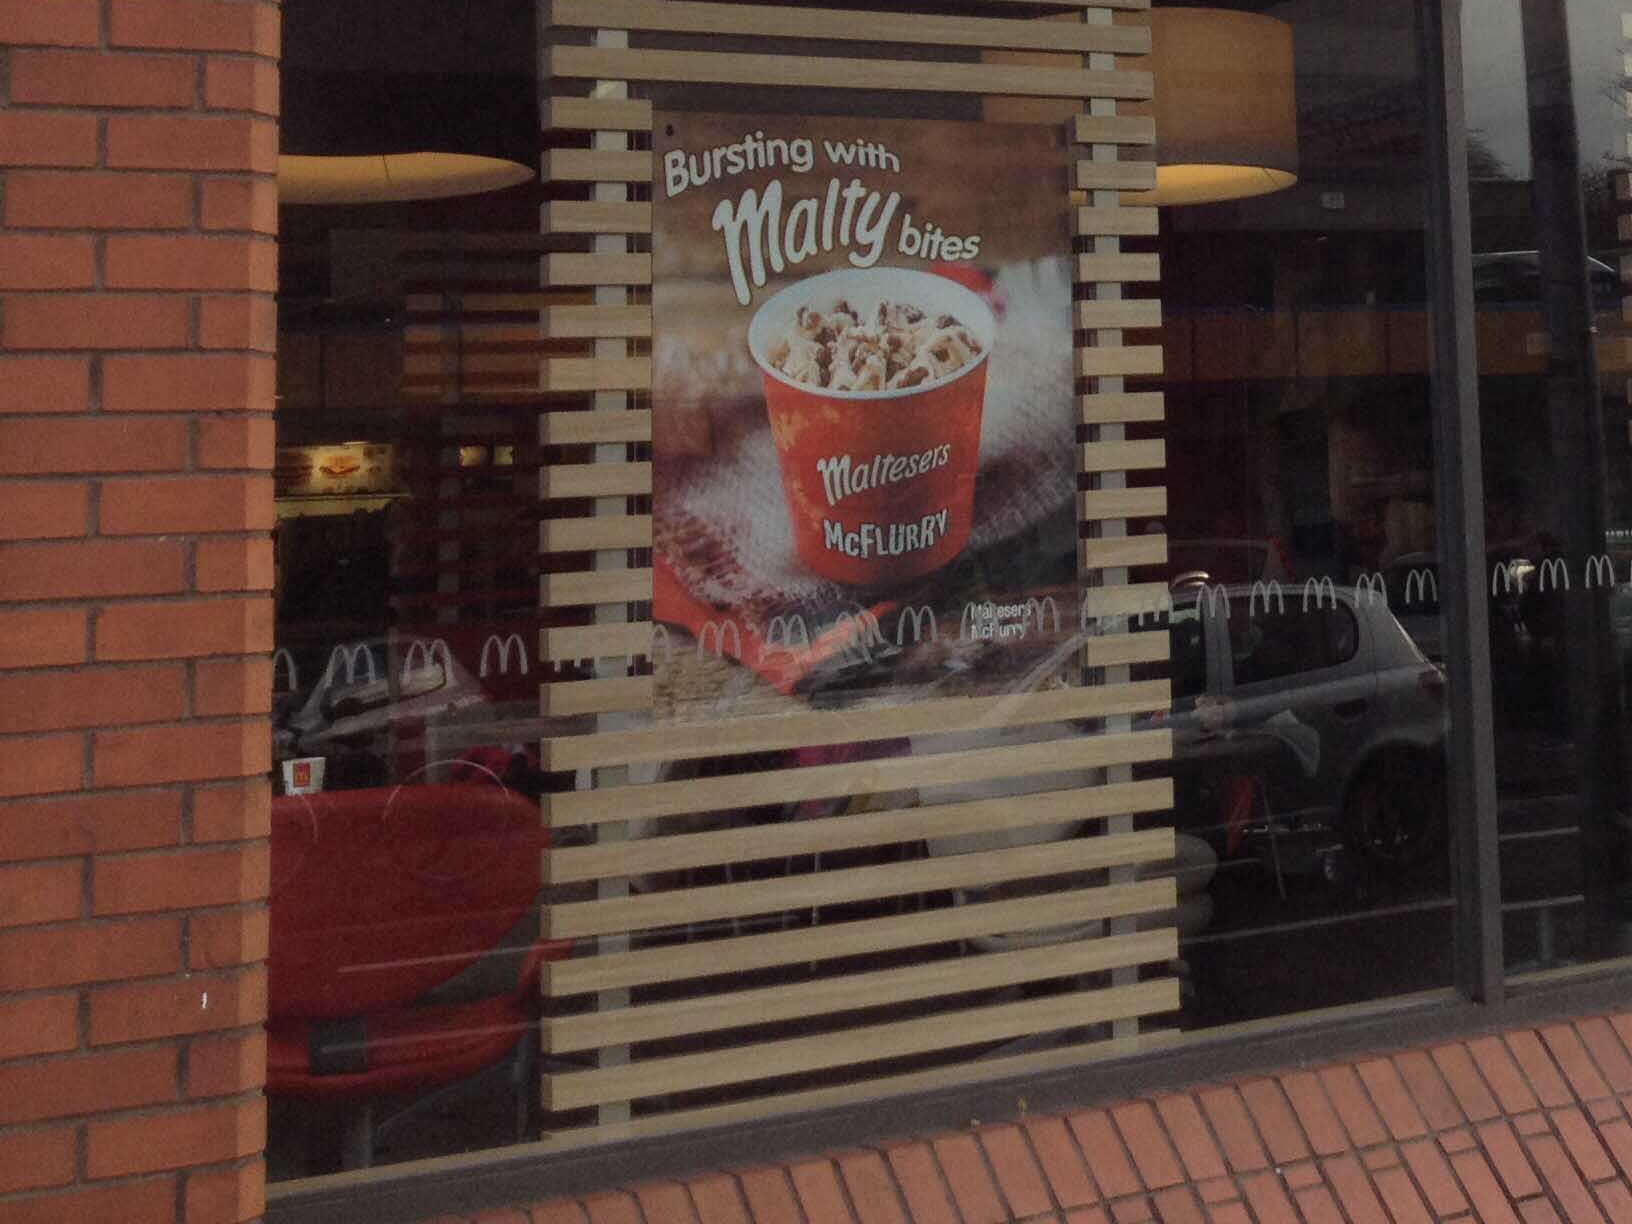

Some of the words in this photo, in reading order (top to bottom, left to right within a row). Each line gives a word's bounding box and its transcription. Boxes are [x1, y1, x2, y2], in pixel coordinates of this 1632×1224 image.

[664, 130, 815, 198] Bursting
[823, 138, 900, 173] with
[711, 178, 901, 306] Malty
[899, 214, 981, 262] bites
[816, 442, 951, 507] Maltesers
